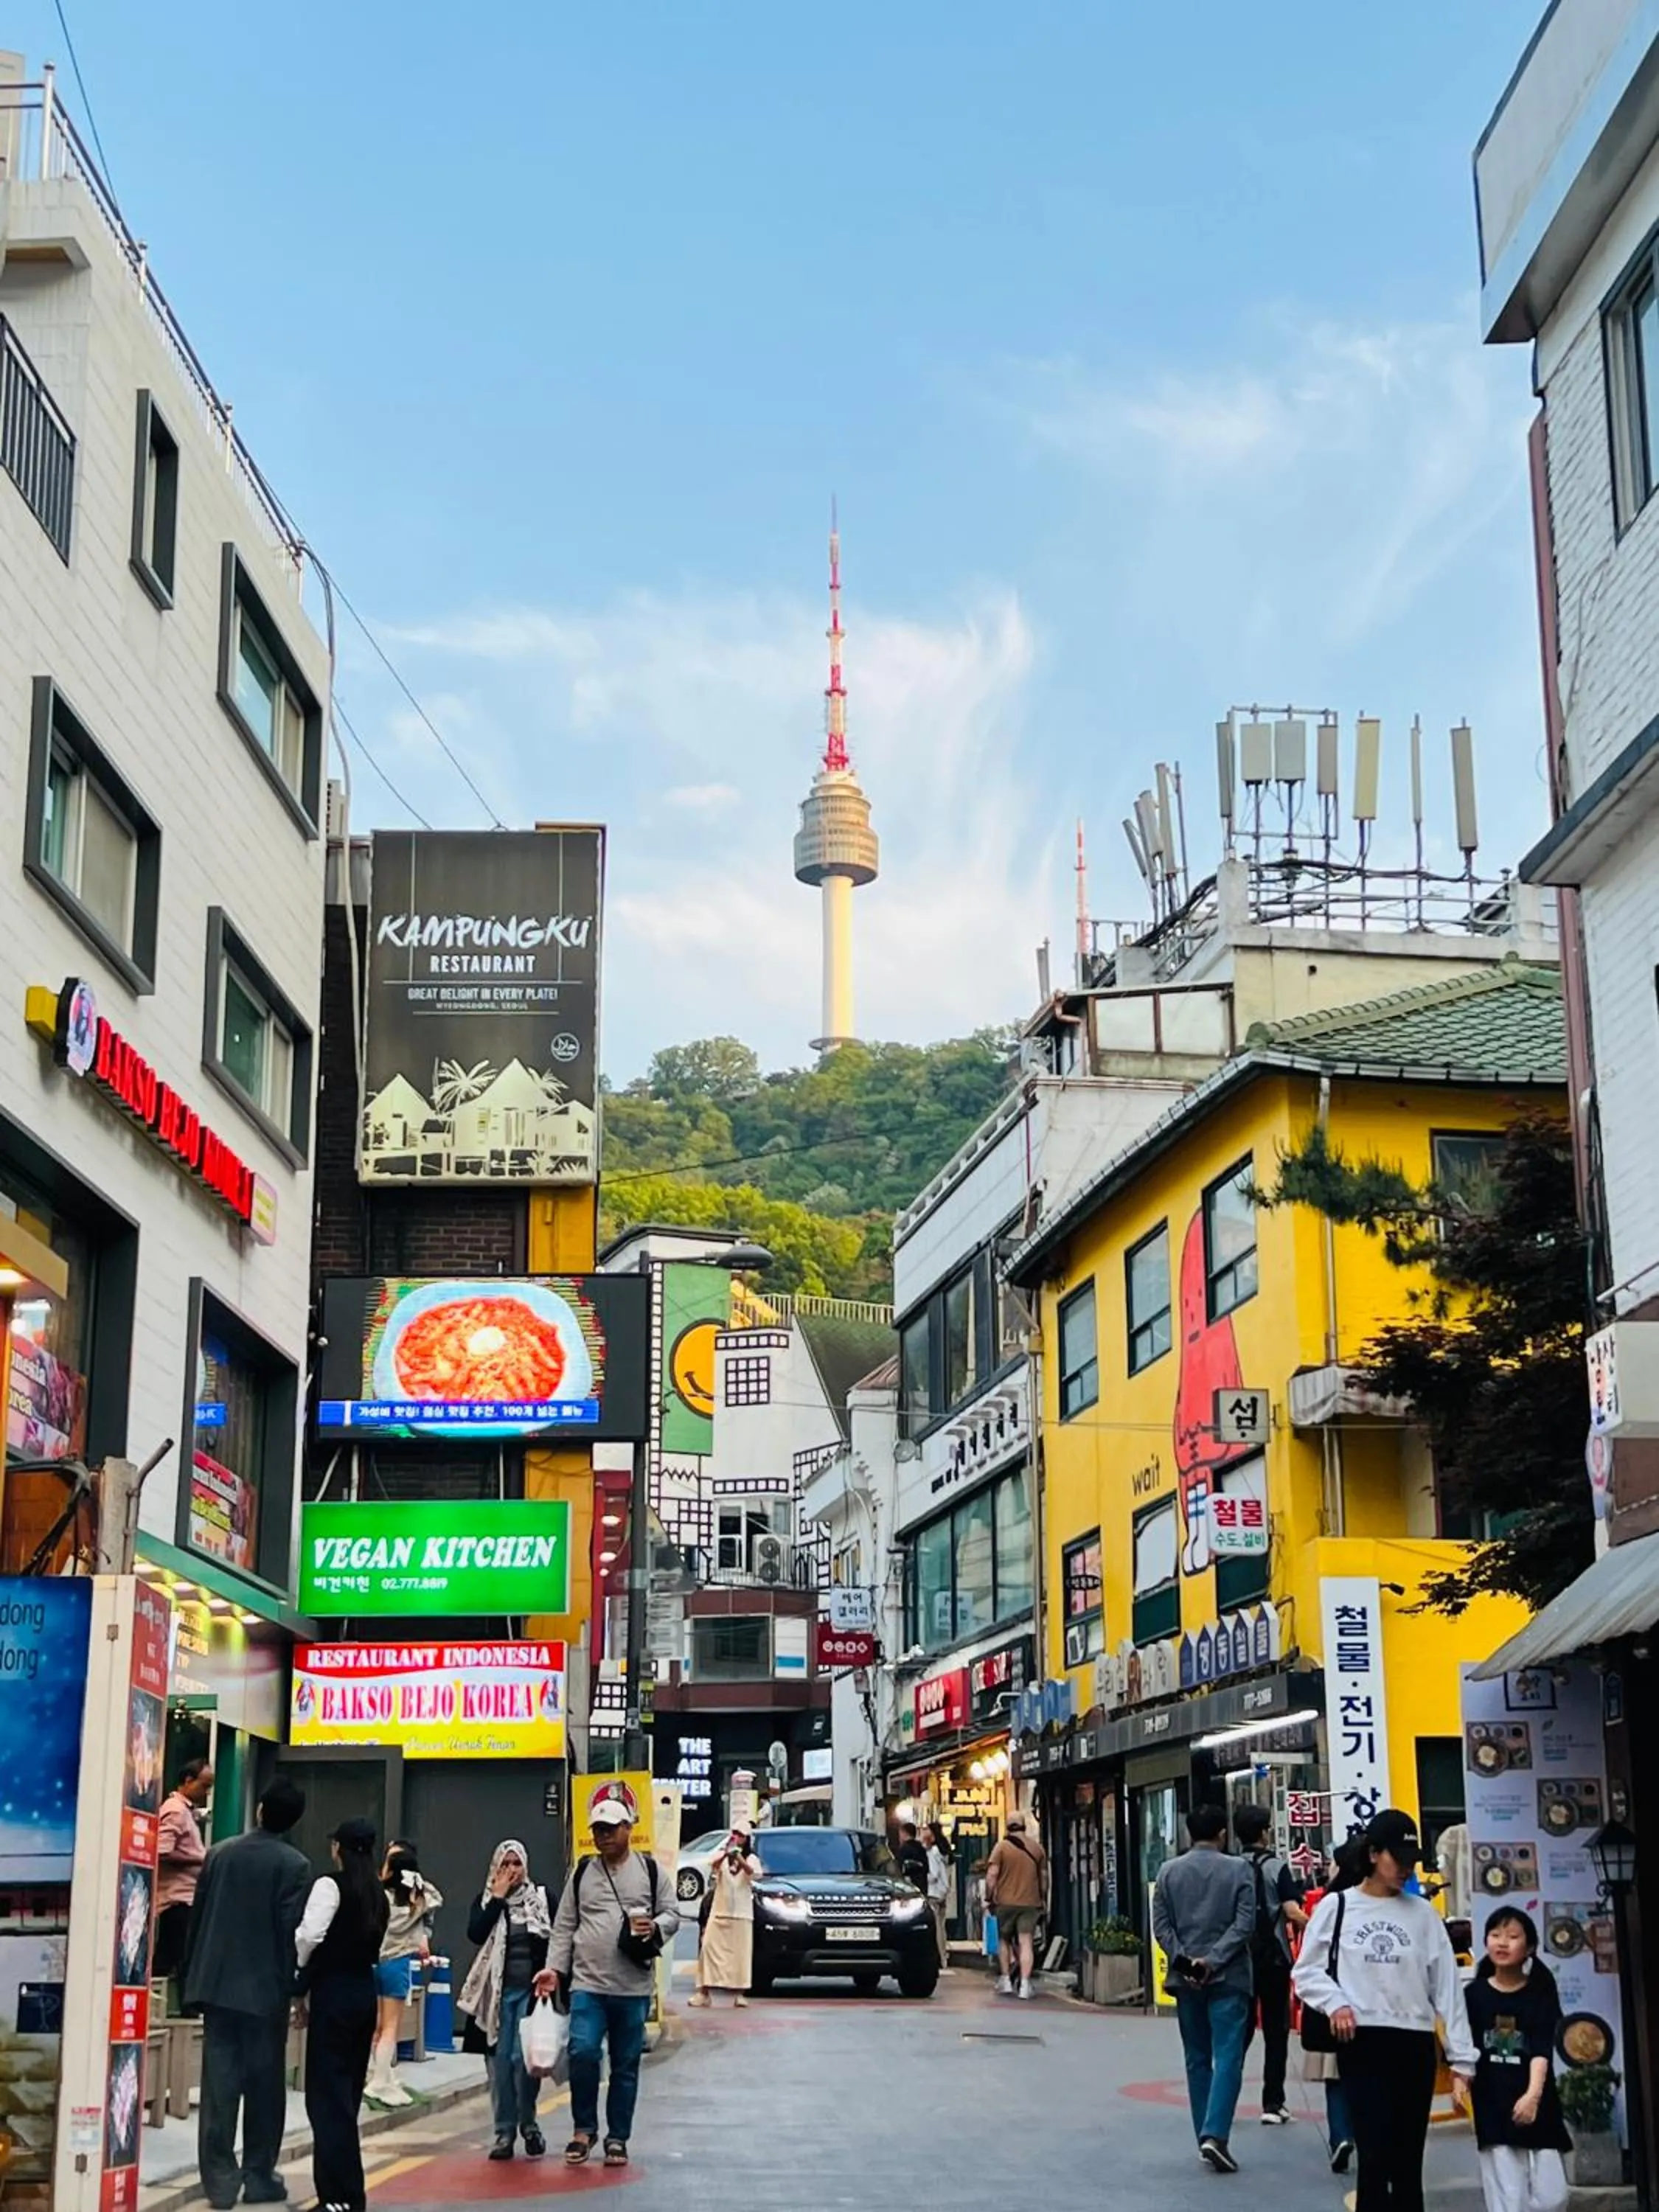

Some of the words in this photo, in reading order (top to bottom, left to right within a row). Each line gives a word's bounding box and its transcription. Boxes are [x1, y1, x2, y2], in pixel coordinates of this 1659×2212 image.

[378, 914, 592, 948] KAMPUNGKU
[429, 955, 535, 973] RESTAURANT
[493, 988, 523, 1000] EVERY
[94, 1016, 157, 1124] BAKSO
[1132, 1453, 1161, 1496] wait
[1214, 1498, 1263, 1527] 철물
[313, 1537, 415, 1570] VEGAN
[421, 1535, 557, 1569] KITCHEN
[307, 1649, 440, 1668] RESTAURANT
[443, 1646, 552, 1666] INDONESIA
[321, 1685, 394, 1720] BAKSO
[400, 1684, 456, 1719] BEJO
[461, 1683, 535, 1719] KOREA
[678, 1737, 712, 1755] THE
[677, 1758, 712, 1775] ART
